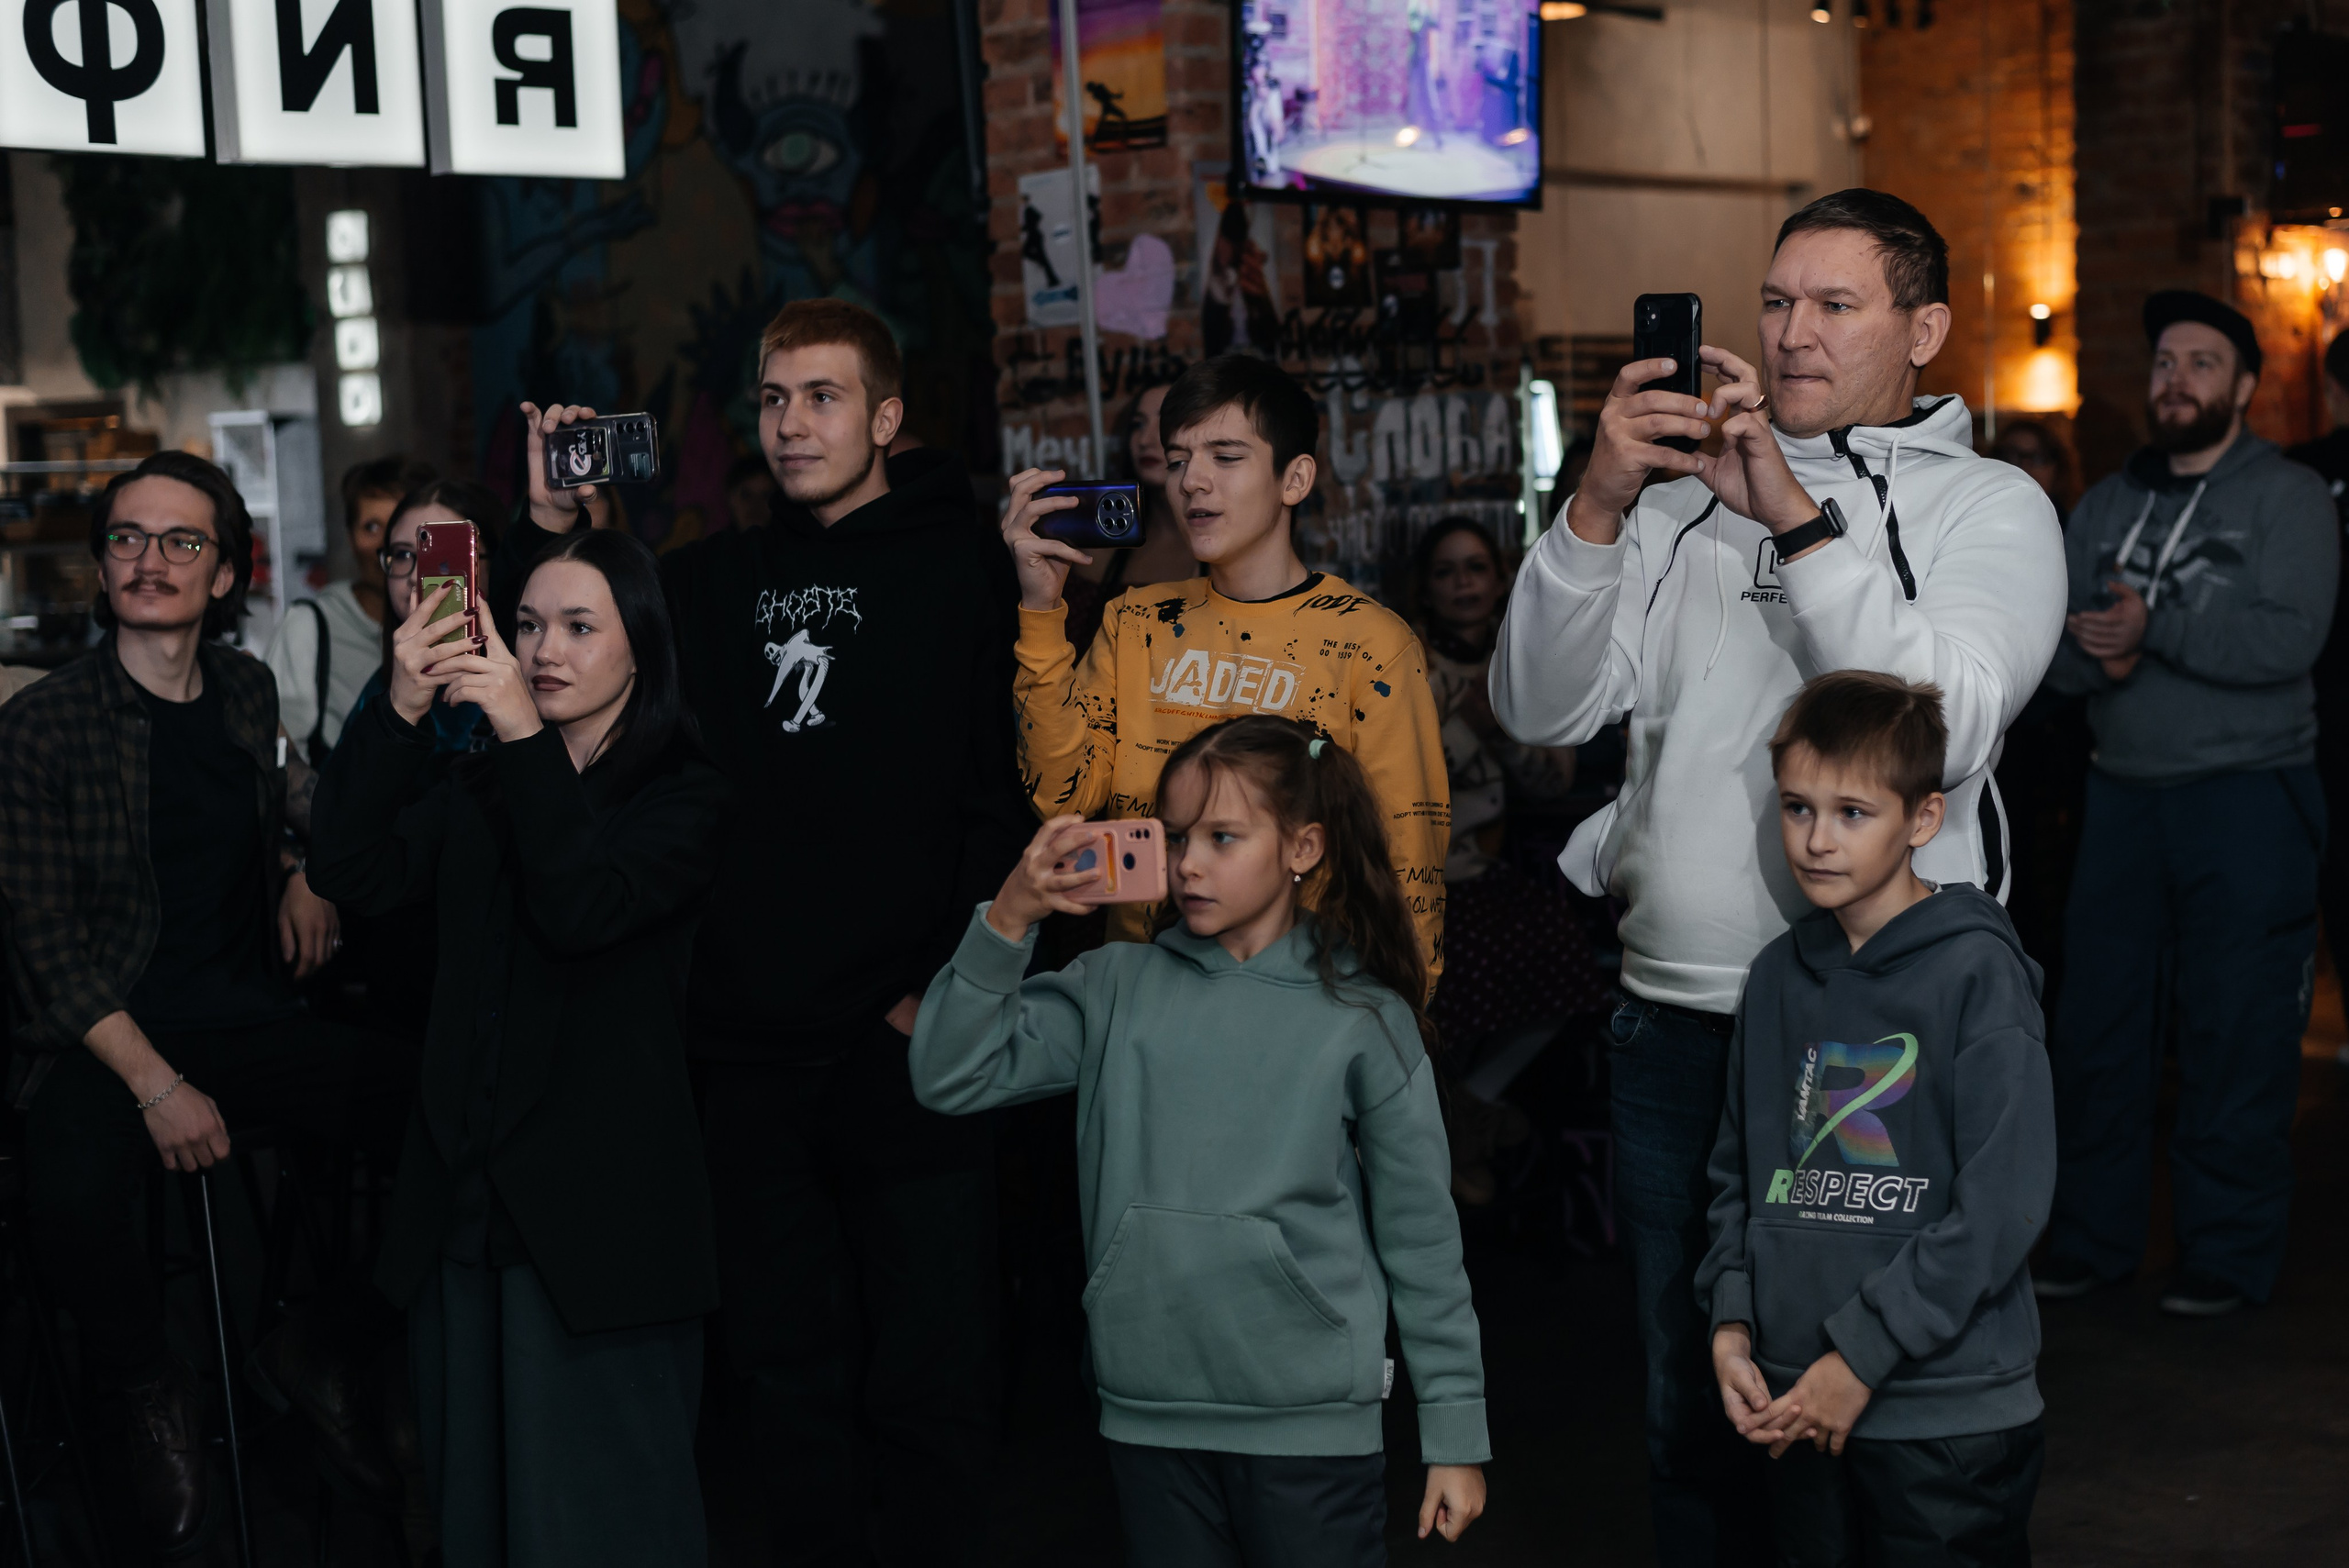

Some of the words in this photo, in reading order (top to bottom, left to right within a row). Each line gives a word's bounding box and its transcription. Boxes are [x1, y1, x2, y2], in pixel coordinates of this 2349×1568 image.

[1323, 639, 1338, 649] THE
[1362, 651, 1373, 662] OF
[1150, 649, 1296, 711] JADED
[1135, 742, 1152, 752] ADOPT
[1765, 1168, 1930, 1213] RESPECT
[1833, 1213, 1874, 1224] COLLECTION
